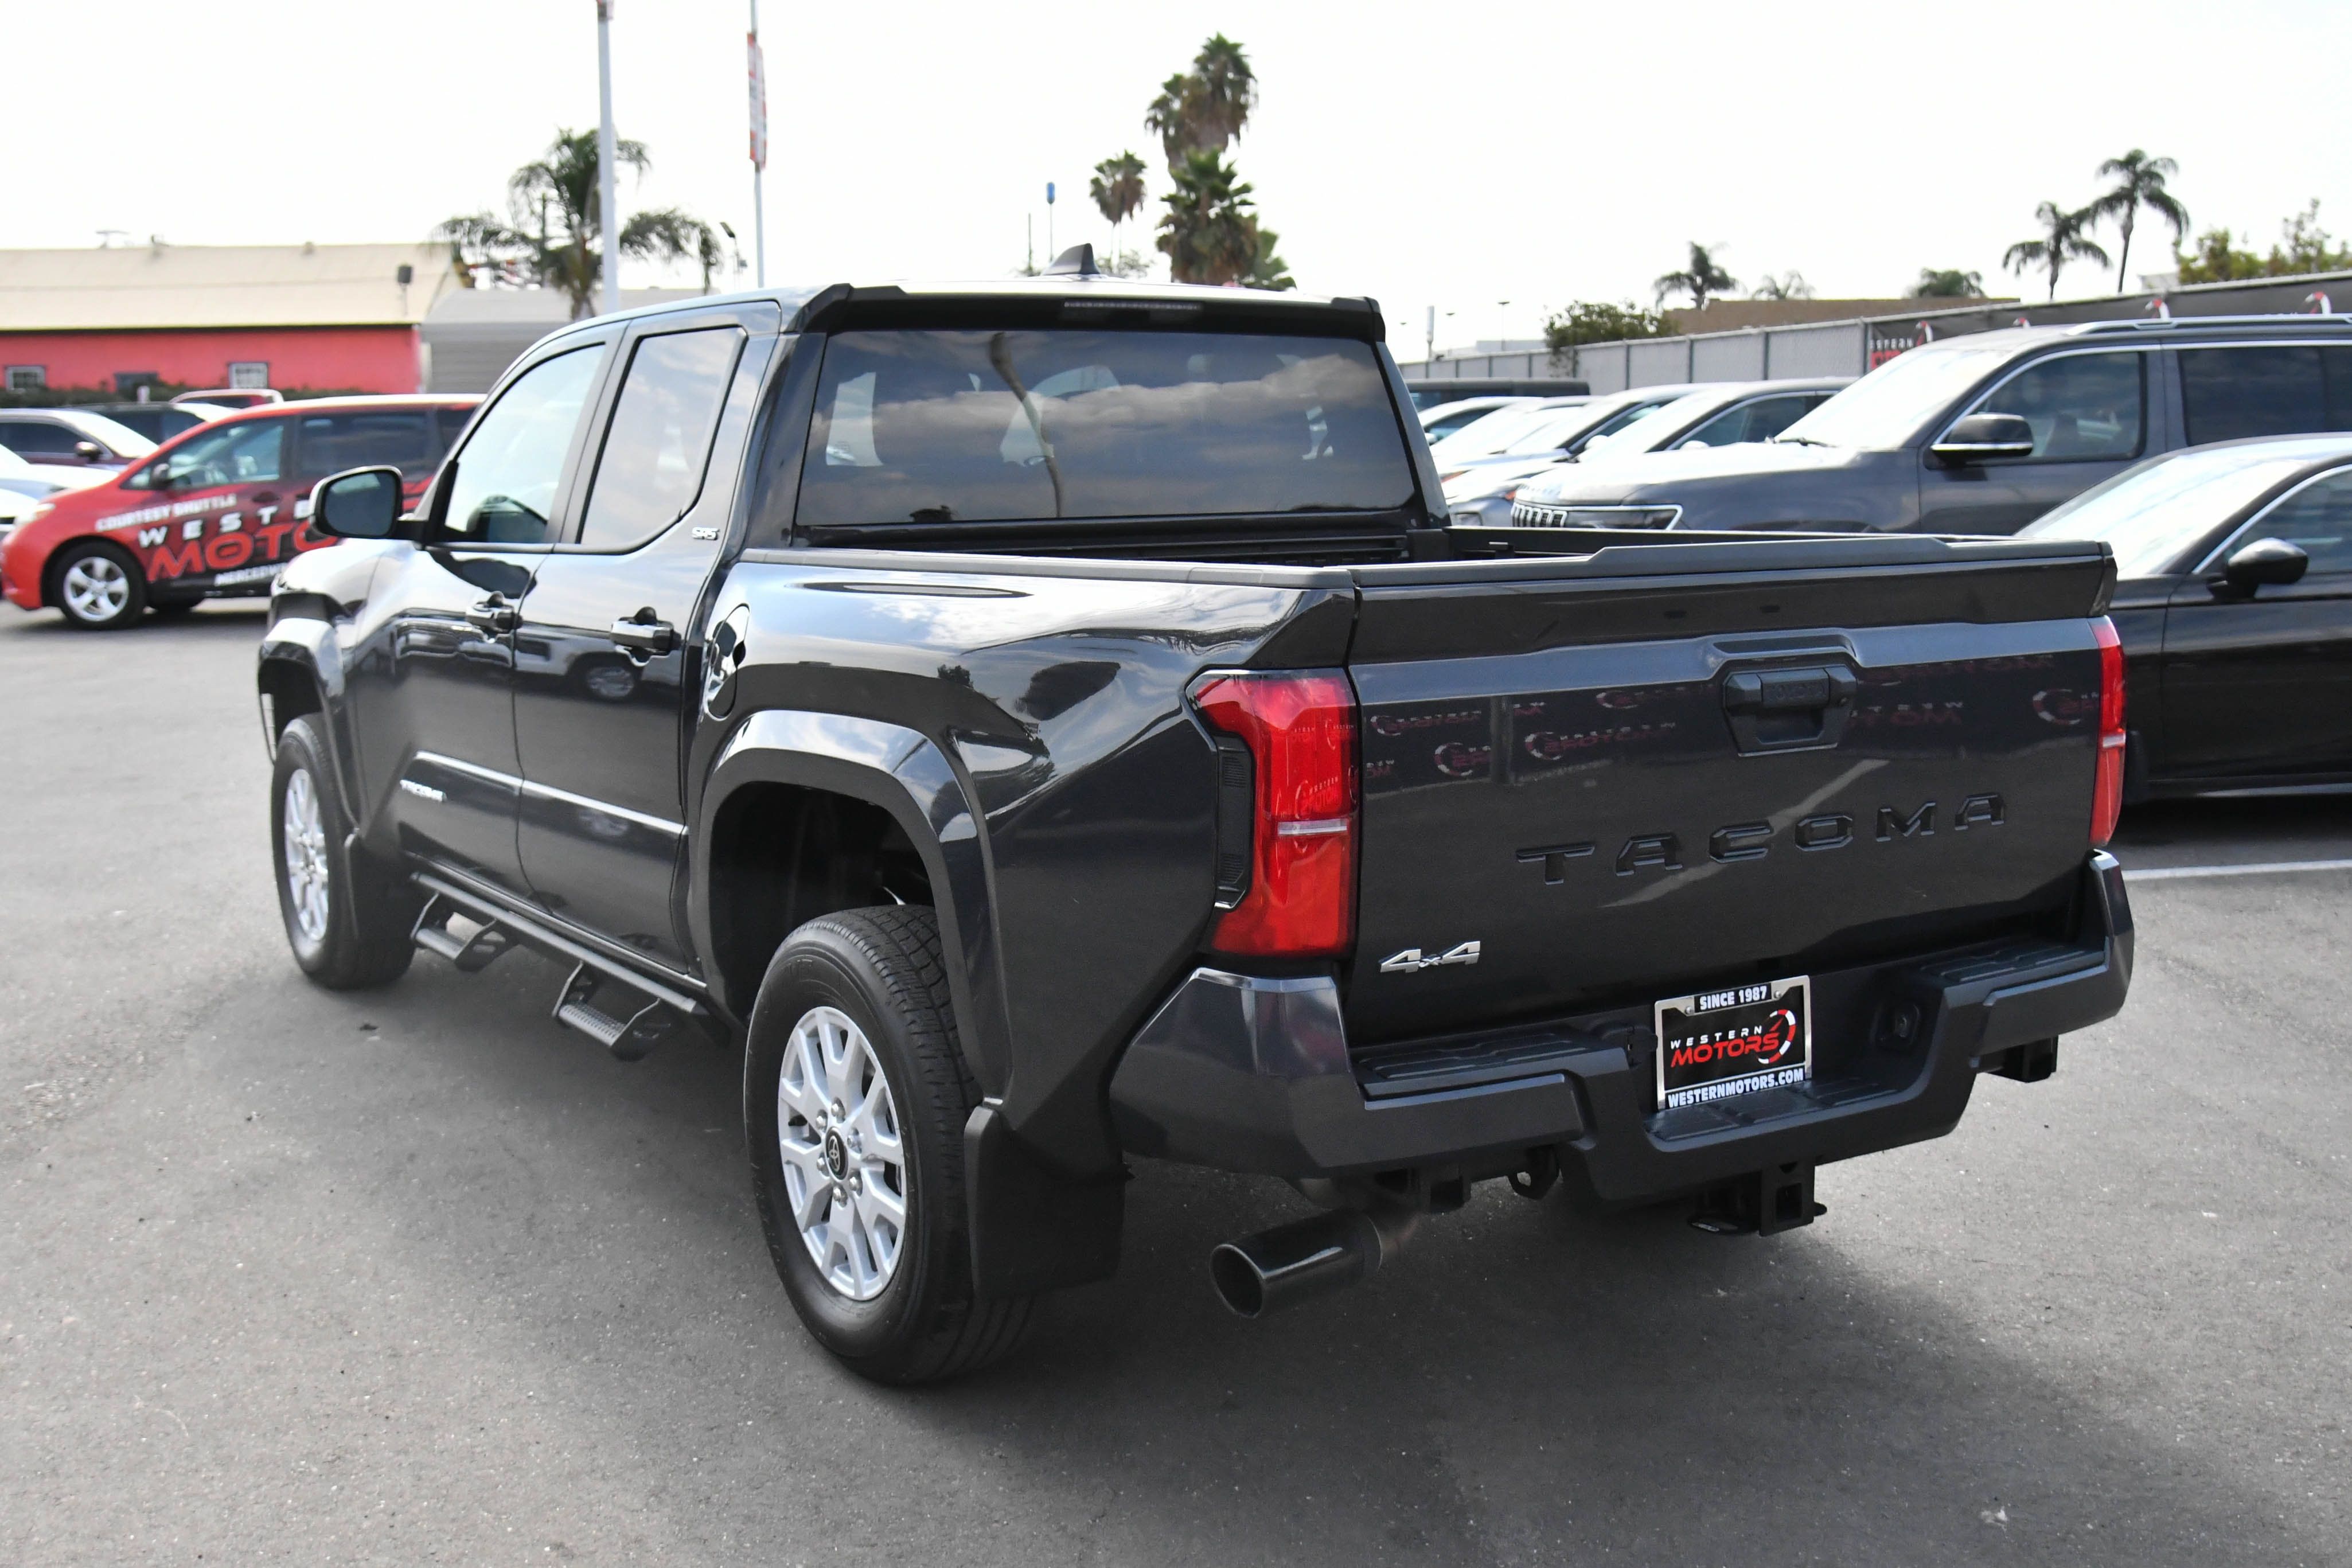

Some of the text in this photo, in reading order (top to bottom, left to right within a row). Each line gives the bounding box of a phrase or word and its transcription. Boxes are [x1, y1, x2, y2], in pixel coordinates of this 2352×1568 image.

[1515, 793, 2005, 886] TACOMA
[1699, 985, 1767, 1011] SINCE 1987
[1670, 1025, 1762, 1050] WESTERN
[1670, 1032, 1781, 1068] MOTORS
[1667, 1068, 1804, 1109] WESTERNMOTORS.COM
